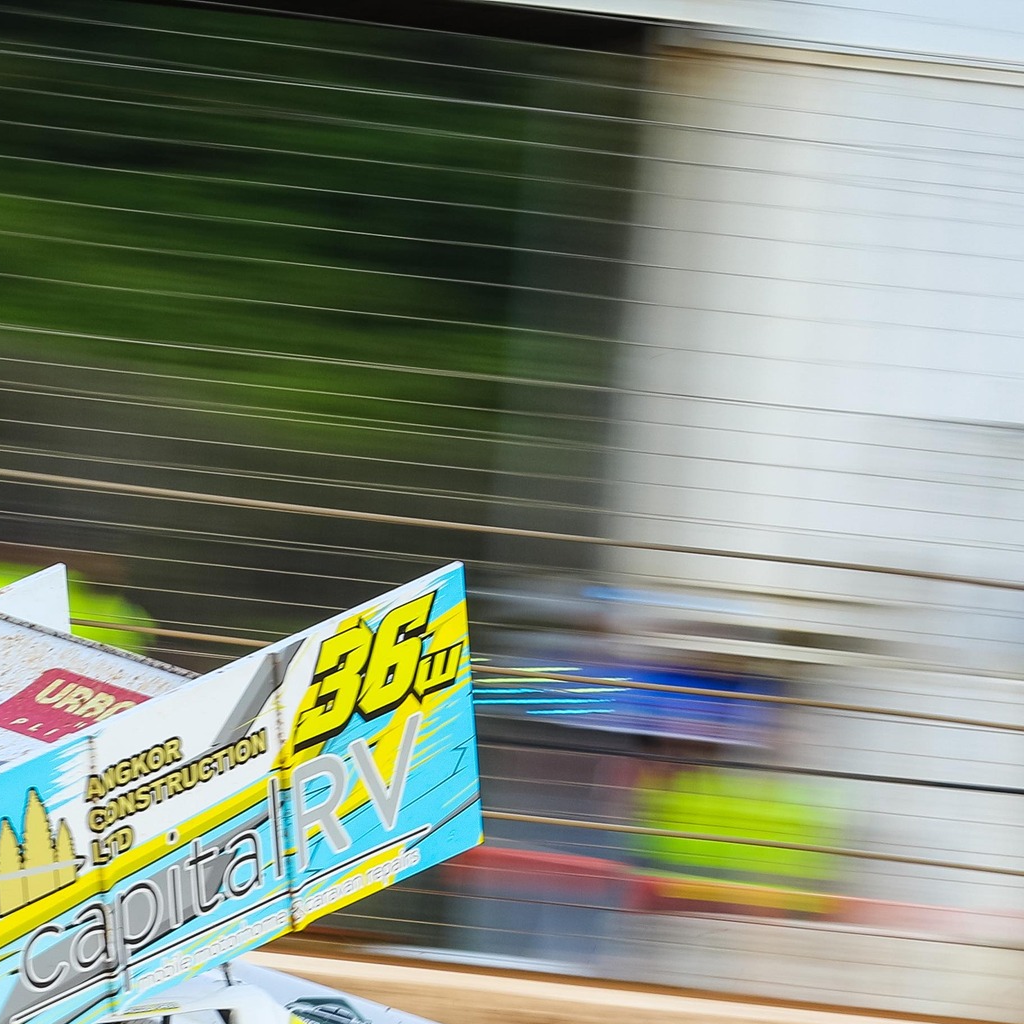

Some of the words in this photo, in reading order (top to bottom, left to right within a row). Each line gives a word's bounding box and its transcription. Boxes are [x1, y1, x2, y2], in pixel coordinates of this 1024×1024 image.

[85, 737, 183, 803] ANGKOR
[88, 730, 267, 833] CONSTRUCTION
[91, 824, 134, 865] LTD
